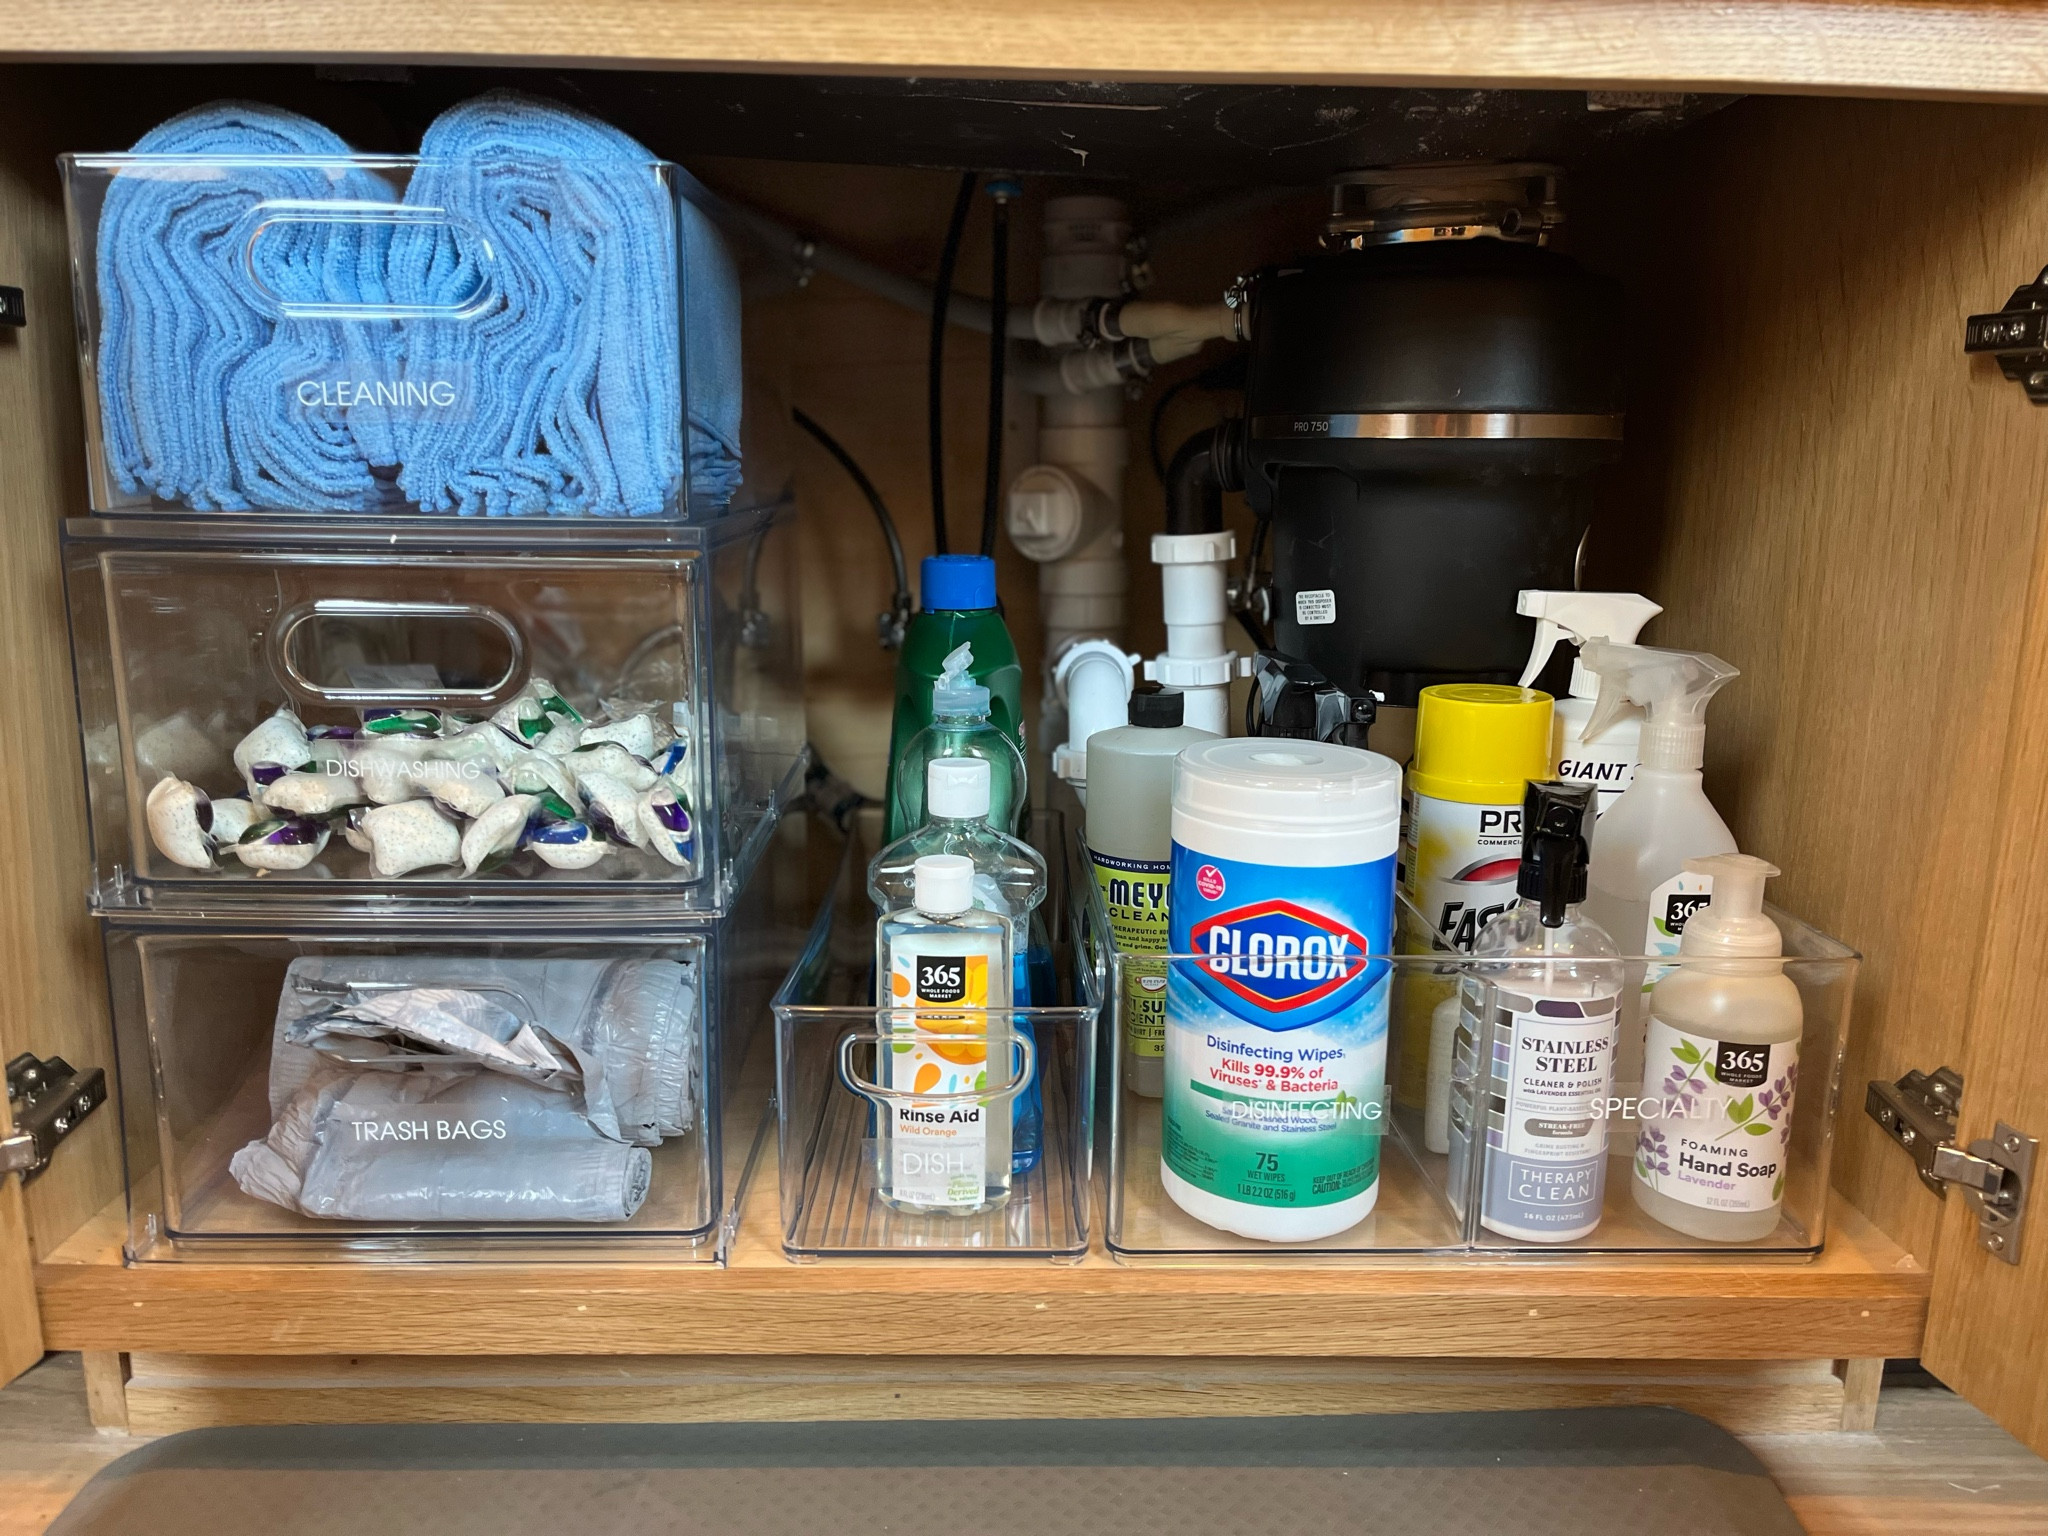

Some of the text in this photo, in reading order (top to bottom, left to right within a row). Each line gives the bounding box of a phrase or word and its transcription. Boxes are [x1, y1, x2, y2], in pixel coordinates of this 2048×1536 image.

[297, 381, 455, 406] CLEANING
[1293, 421, 1309, 431] PRO
[326, 759, 481, 780] DISHWASHING
[1558, 760, 1628, 780] GIANT
[1480, 810, 1521, 833] PR
[1093, 855, 1149, 870] HARDWORKING
[1209, 925, 1349, 980] CLOROX
[921, 965, 960, 987] 365
[1207, 1034, 1293, 1063] Disinfecting
[1521, 1036, 1609, 1055] STAINLESS
[1222, 1058, 1324, 1079] Kills 99.9% of
[1535, 1056, 1598, 1073] STEEL
[1721, 1051, 1764, 1072] 365
[1266, 1080, 1276, 1091] &
[1281, 1079, 1338, 1092] Bacteria
[1523, 1077, 1603, 1089] CLEANER & POLISH
[1536, 1089, 1567, 1097] LAVENDER
[900, 1108, 980, 1123] Rinse Aid
[1232, 1101, 1382, 1120] DISINFECTING
[1589, 1097, 1734, 1120] SPECIALTY
[352, 1119, 506, 1141] TRASH BAGS
[1205, 1110, 1230, 1123] Sealed
[1232, 1118, 1261, 1130] Granite
[1281, 1124, 1316, 1132] Stainless
[1318, 1122, 1336, 1131] Steel
[1538, 1122, 1586, 1130] STREAK-FREE
[900, 1124, 957, 1138] Wild Orange
[1681, 1138, 1748, 1157] FOAMING
[902, 1152, 964, 1174] DISH
[1255, 1152, 1279, 1171] 75
[1679, 1152, 1777, 1179] Hand Soap
[1247, 1169, 1286, 1183] WET WIPES
[1313, 1175, 1325, 1184] KEEP
[1327, 1173, 1336, 1182] OUT
[1336, 1172, 1342, 1180] OF
[1520, 1168, 1592, 1184] THERAPY
[1677, 1170, 1736, 1190] Lavender
[1242, 1184, 1251, 1195] LB
[1252, 1186, 1263, 1197] 2.2
[1263, 1188, 1273, 1199] OZ
[1274, 1189, 1288, 1200] (516
[1289, 1190, 1296, 1202] g)
[1312, 1180, 1342, 1194] CAUTION:
[1519, 1184, 1589, 1200] CLEAN
